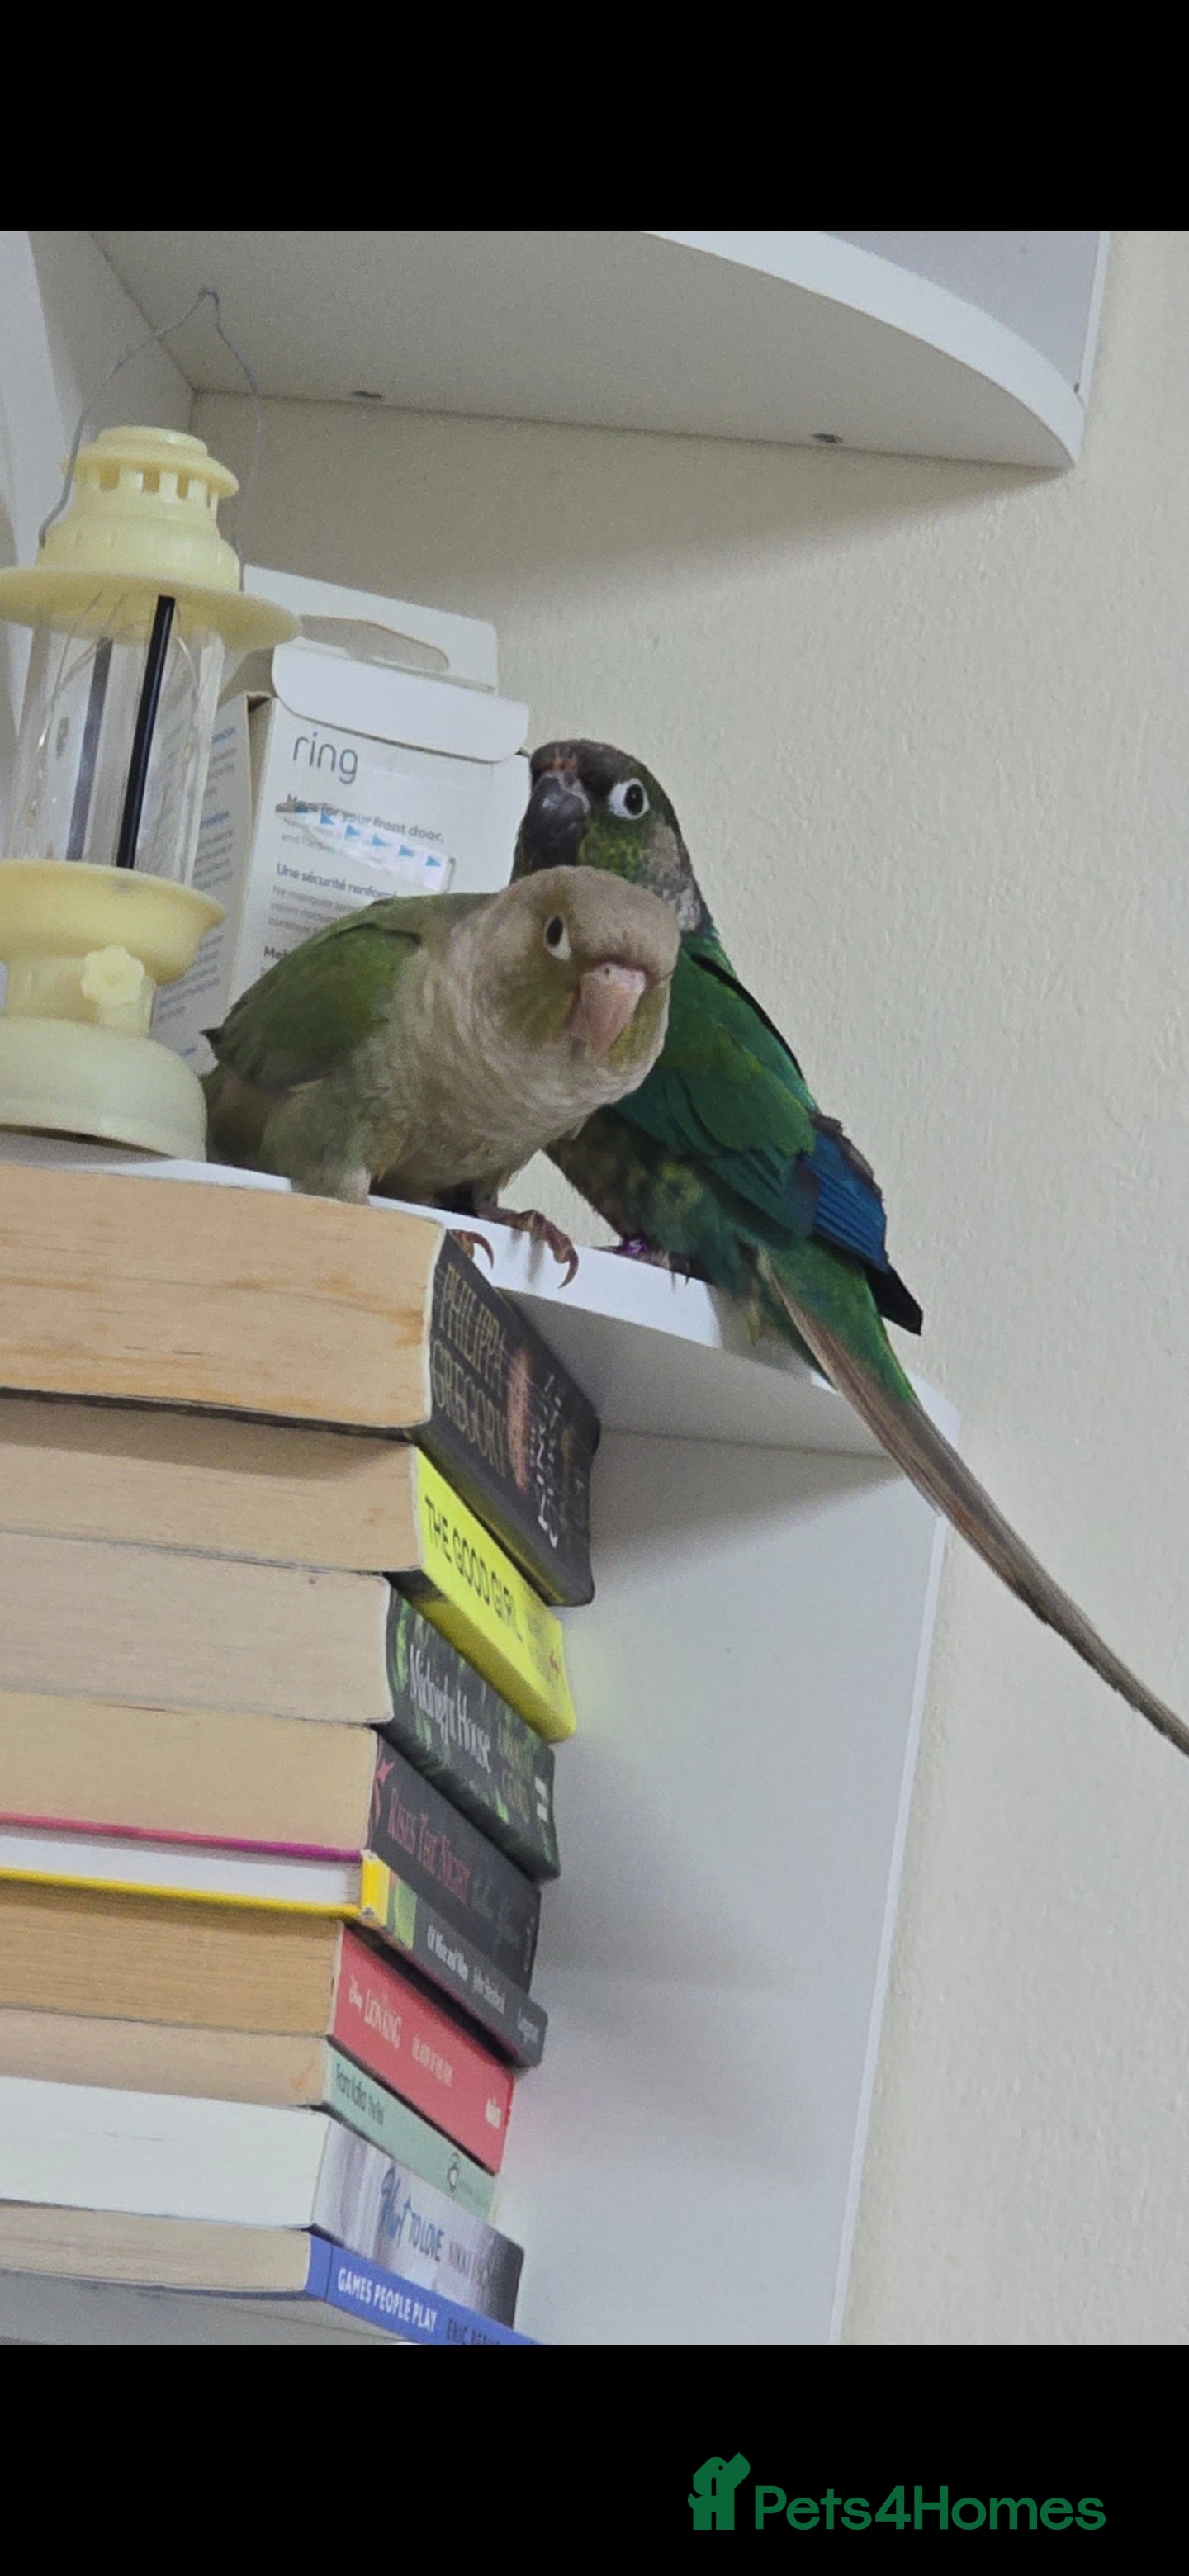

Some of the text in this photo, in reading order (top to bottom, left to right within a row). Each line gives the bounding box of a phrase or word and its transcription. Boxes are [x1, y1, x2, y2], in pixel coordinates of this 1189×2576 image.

[292, 732, 358, 784] ring
[373, 816, 406, 834] front
[277, 862, 301, 880] Une
[439, 1261, 509, 1400] PHILIPPA
[433, 1338, 508, 1480] GREGORY
[424, 1494, 523, 1645] THE GOOD GIRL
[457, 1688, 493, 1773] House
[364, 1988, 382, 2034] LION
[381, 2007, 403, 2051] KING
[420, 2219, 445, 2263] LOVE
[337, 2268, 372, 2304] GAMES
[373, 2283, 411, 2323] PEOPLE
[411, 2301, 438, 2332] PLAY
